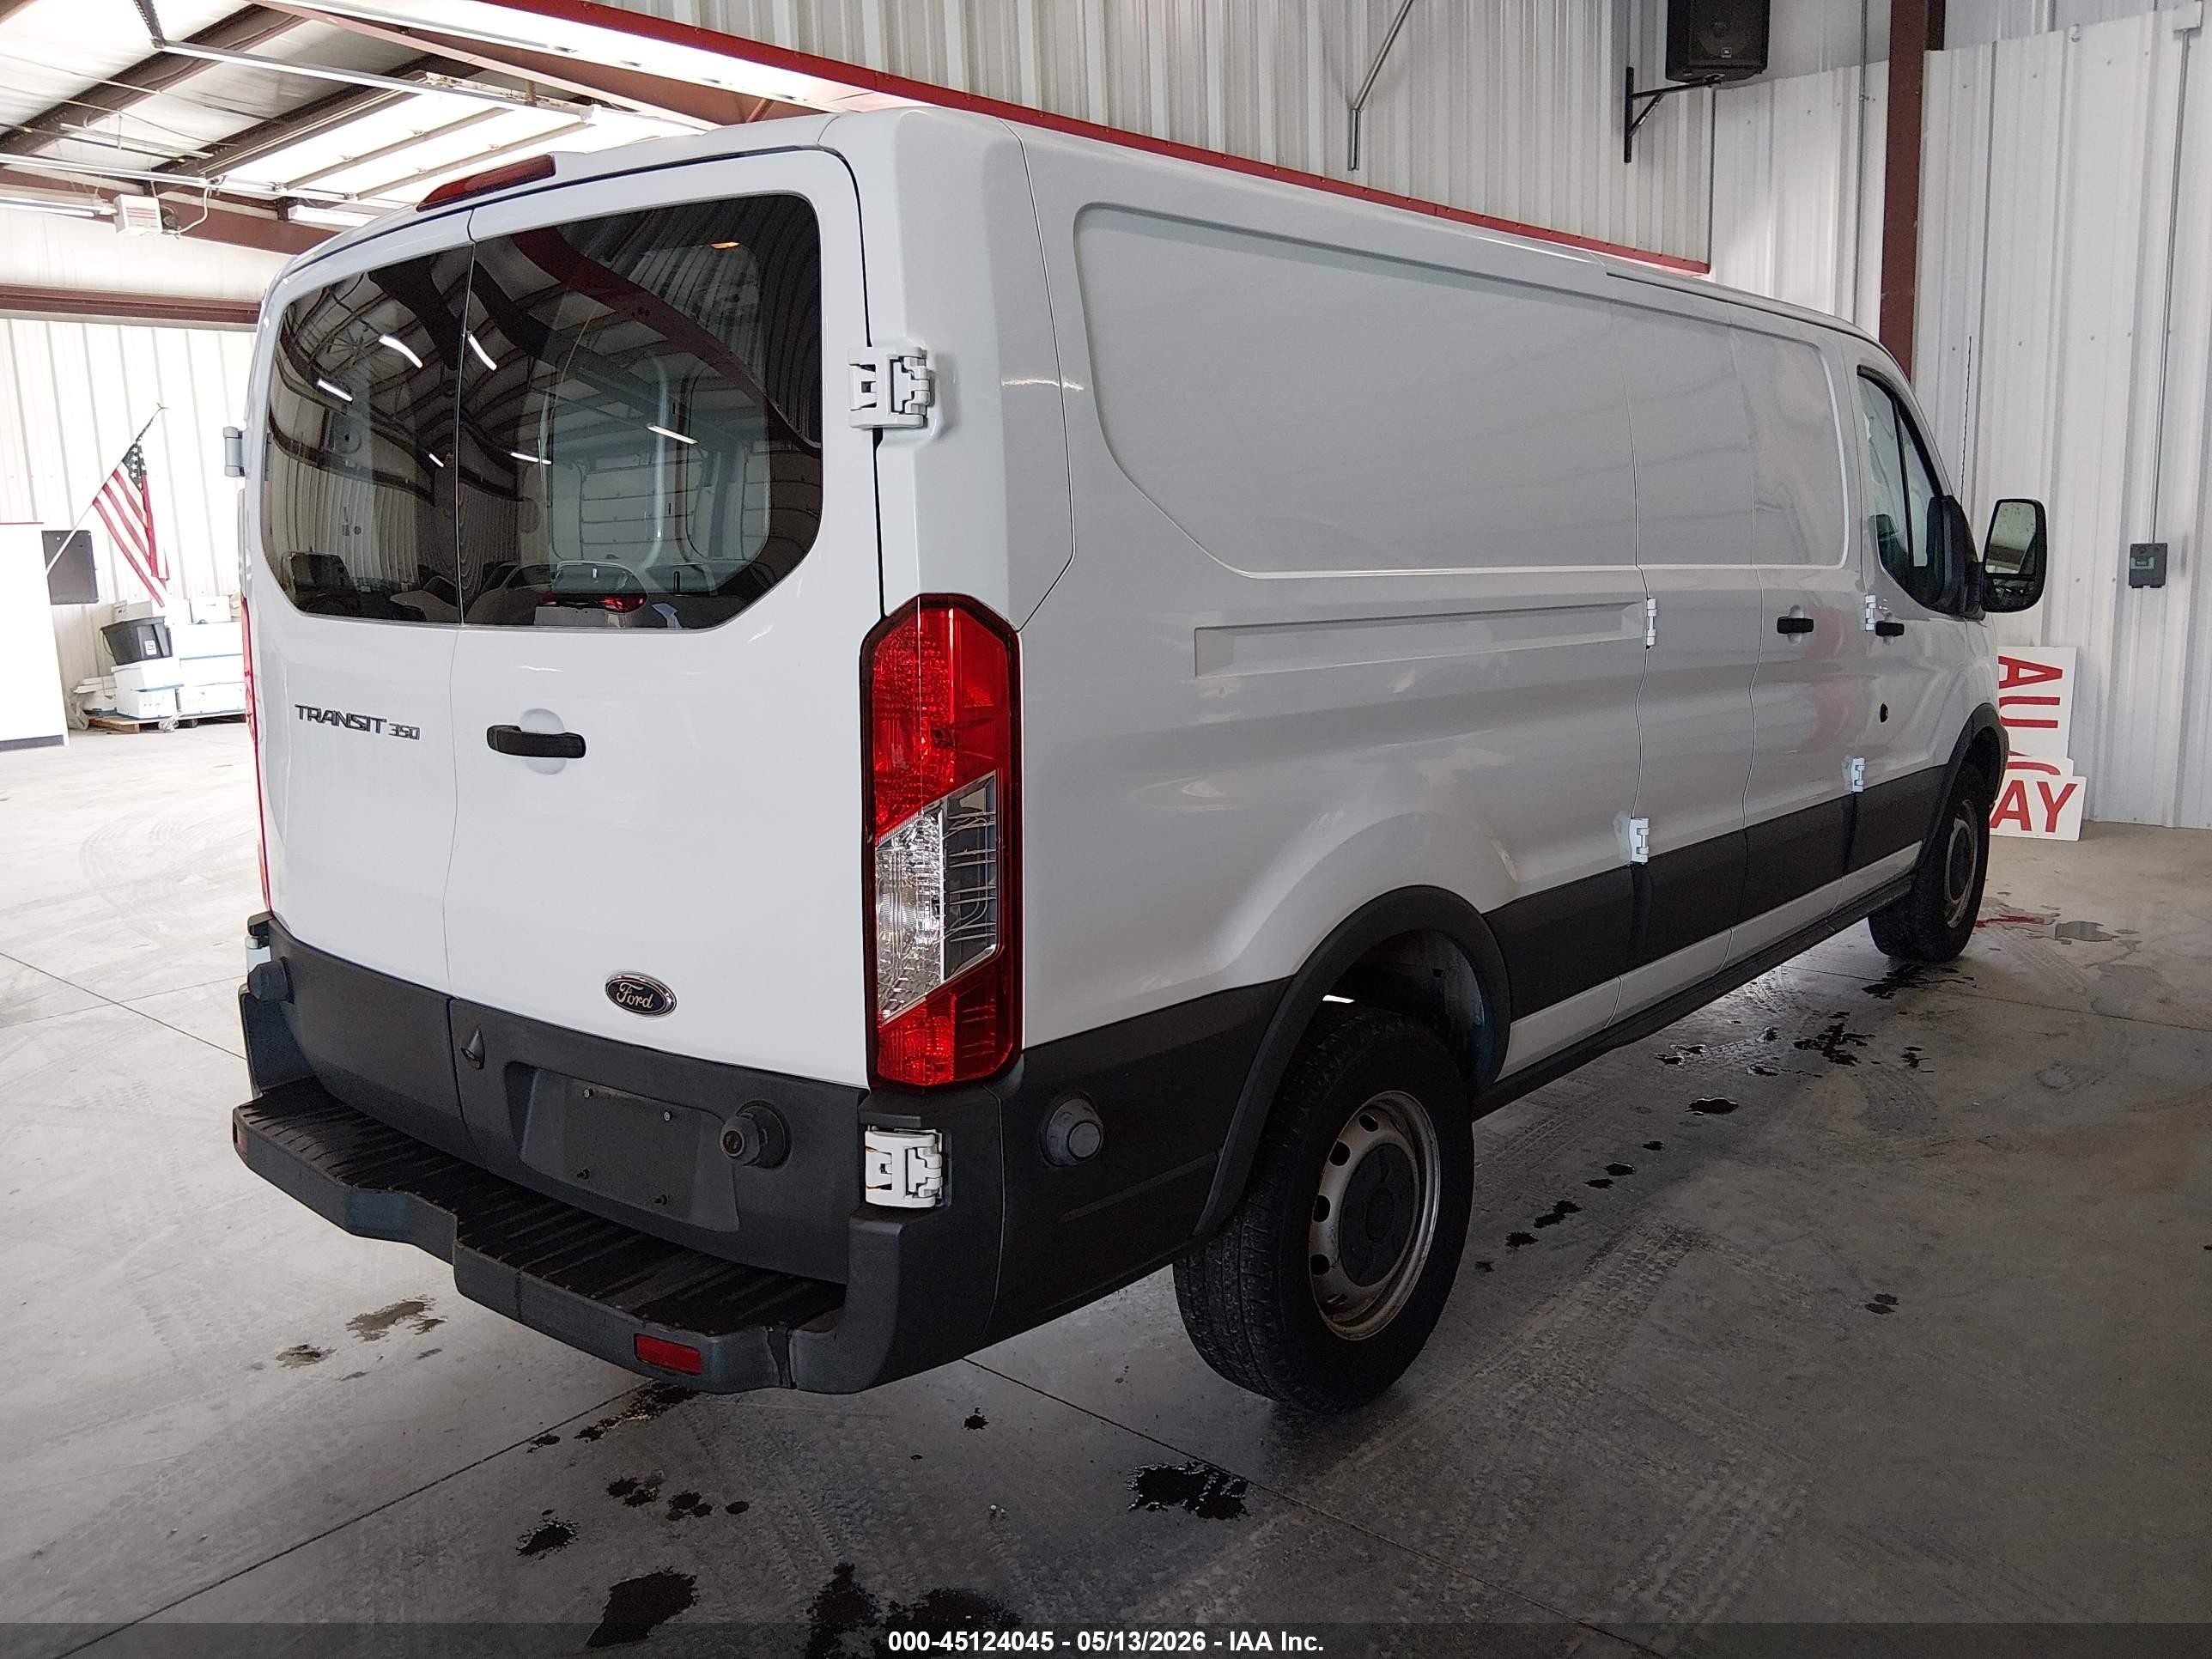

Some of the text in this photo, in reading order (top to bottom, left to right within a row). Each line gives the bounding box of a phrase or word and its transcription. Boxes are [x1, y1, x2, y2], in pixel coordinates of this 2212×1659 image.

[295, 703, 421, 741] TRANSIT 350
[616, 981, 654, 1009] Ford
